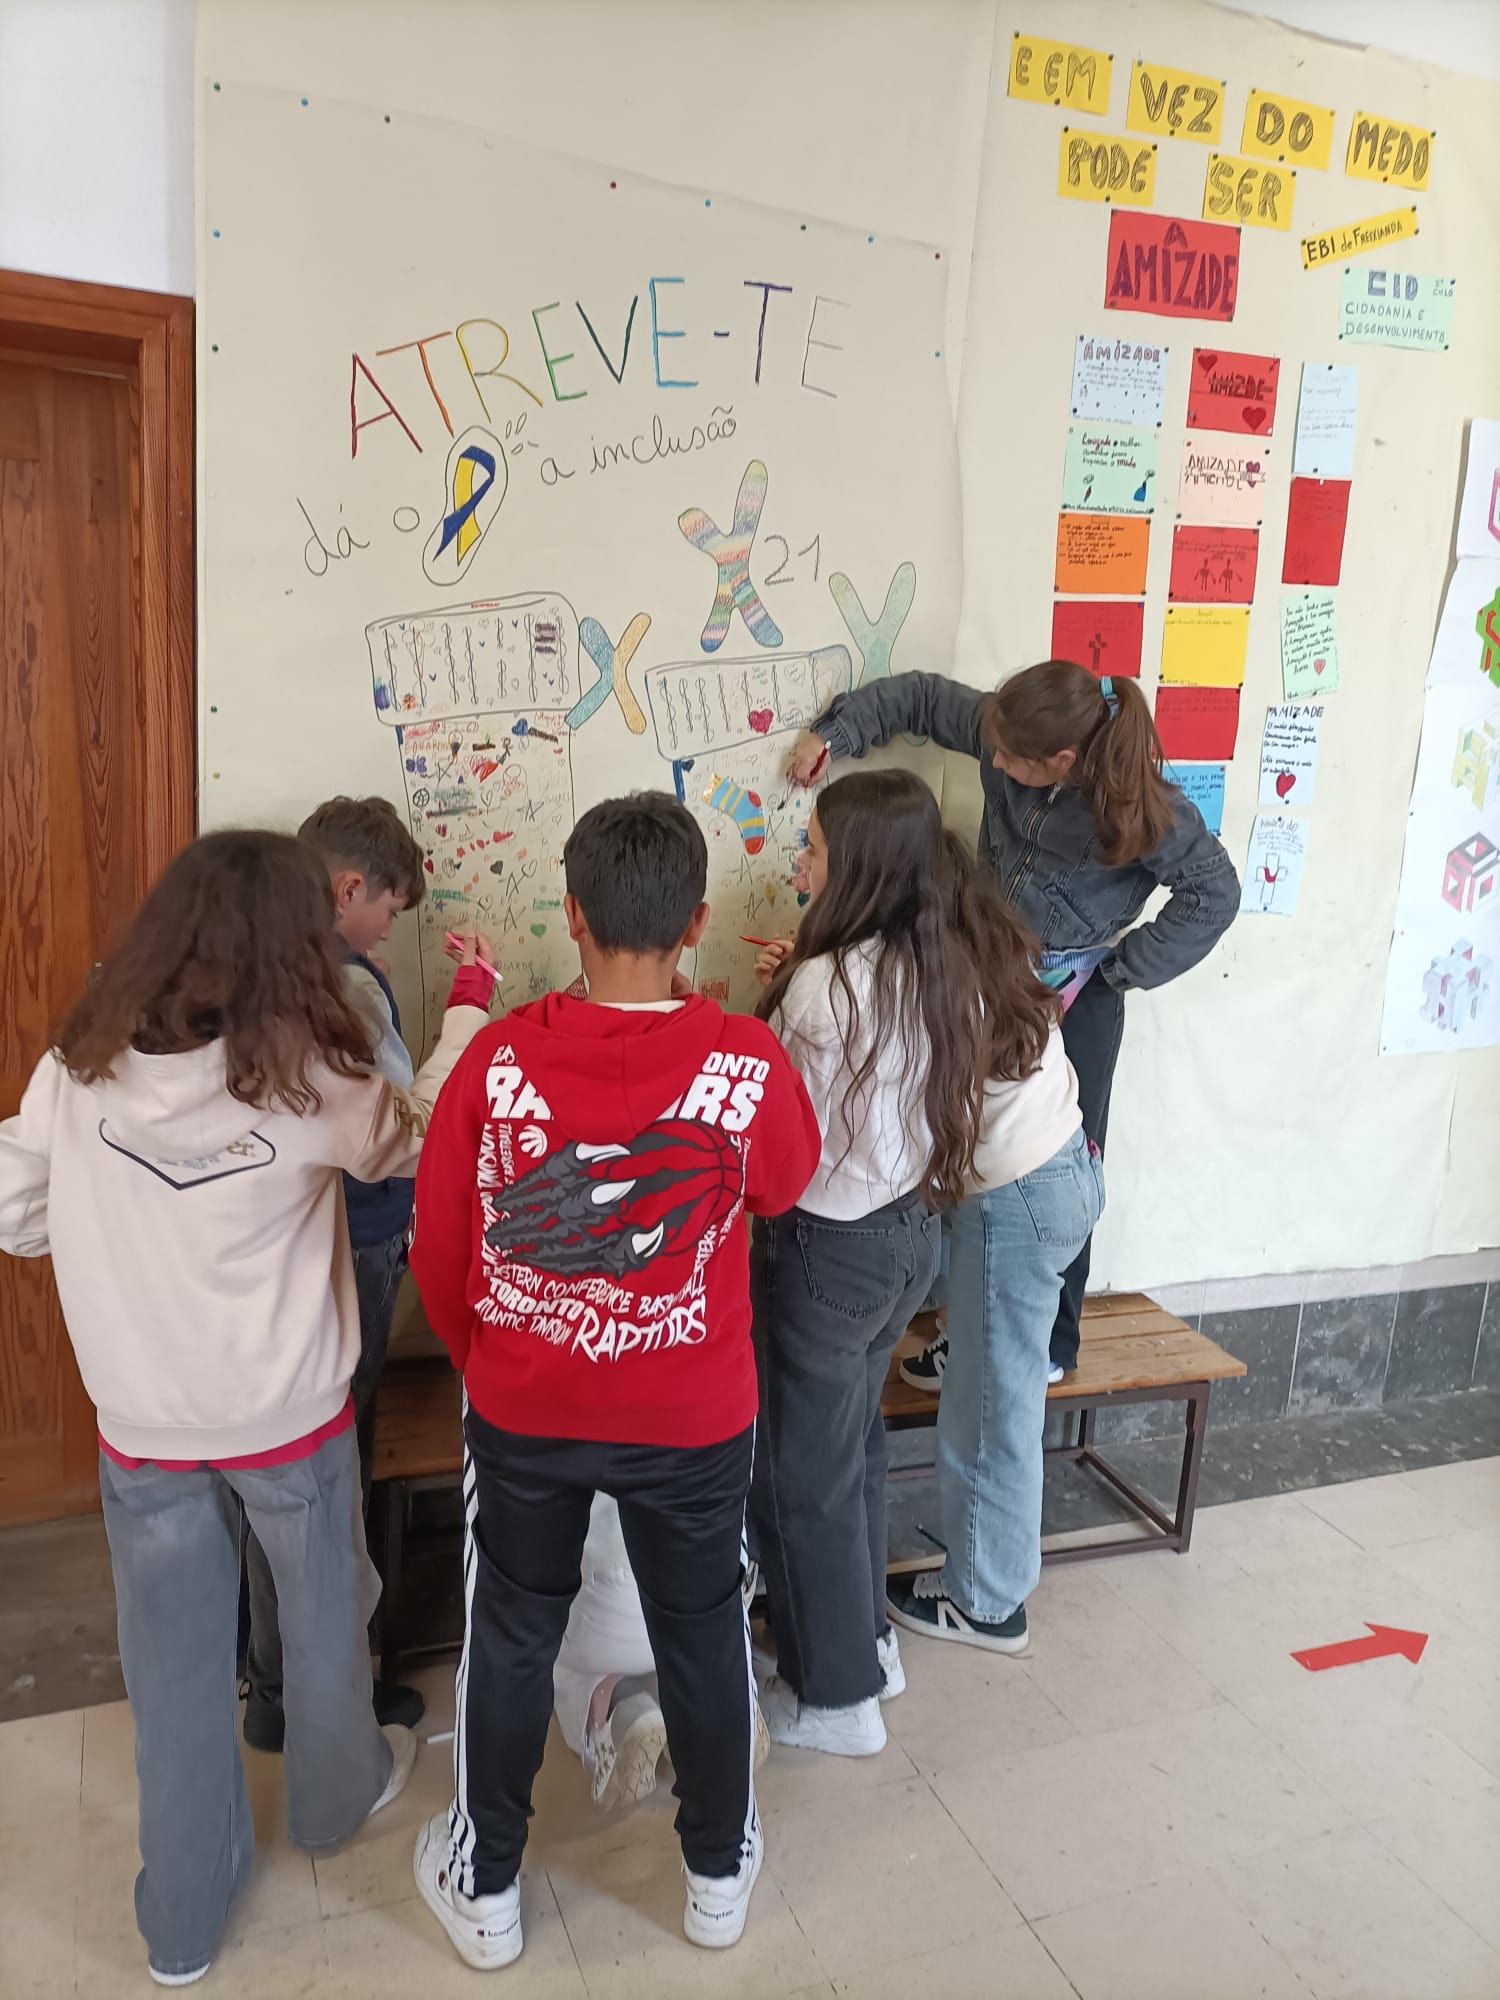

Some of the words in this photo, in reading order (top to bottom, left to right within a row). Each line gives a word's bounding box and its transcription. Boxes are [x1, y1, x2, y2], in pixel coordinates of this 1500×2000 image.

[1014, 46, 1033, 87] E
[1043, 51, 1097, 101] EM
[1139, 71, 1219, 133] VEZ
[1255, 101, 1314, 153] DO
[1353, 119, 1429, 182] MEDO
[1067, 137, 1152, 193] PODE
[1208, 164, 1283, 222] SER
[1307, 236, 1336, 262] EBI
[1110, 239, 1237, 313] AMIZADE
[1368, 270, 1418, 301] CID
[1344, 322, 1445, 343] DESENVOLVIMENTO
[1345, 302, 1412, 320] CIDADANIA
[1418, 309, 1425, 321] E
[351, 277, 852, 461] ATREVE-TE
[1083, 342, 1160, 363] AMIZADE
[297, 497, 371, 576] dá
[590, 405, 737, 475] inclusão
[1270, 704, 1324, 718] AMIZADE
[486, 1066, 554, 1120] RA
[474, 1296, 525, 1333] ATLANTIC
[489, 1277, 585, 1322] TORONTO
[570, 1293, 707, 1363] RAPTORS
